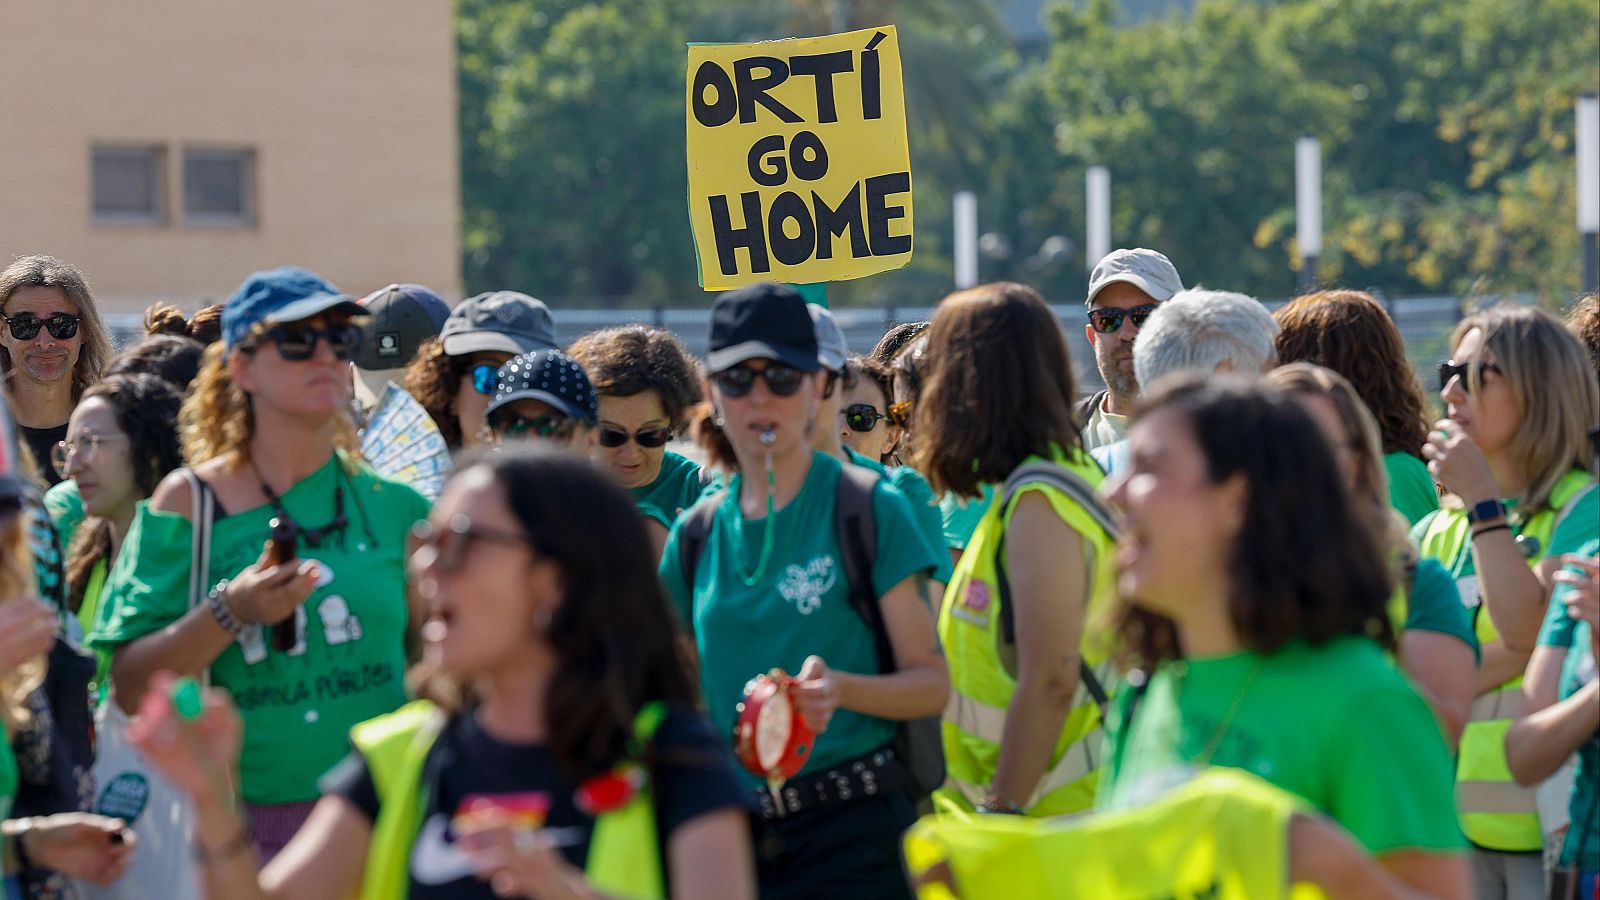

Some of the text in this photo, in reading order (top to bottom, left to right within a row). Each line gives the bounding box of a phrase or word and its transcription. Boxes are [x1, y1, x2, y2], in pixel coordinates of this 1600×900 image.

[692, 31, 888, 127] ORTÍ
[747, 130, 829, 187] GO
[707, 171, 912, 275] HOME
